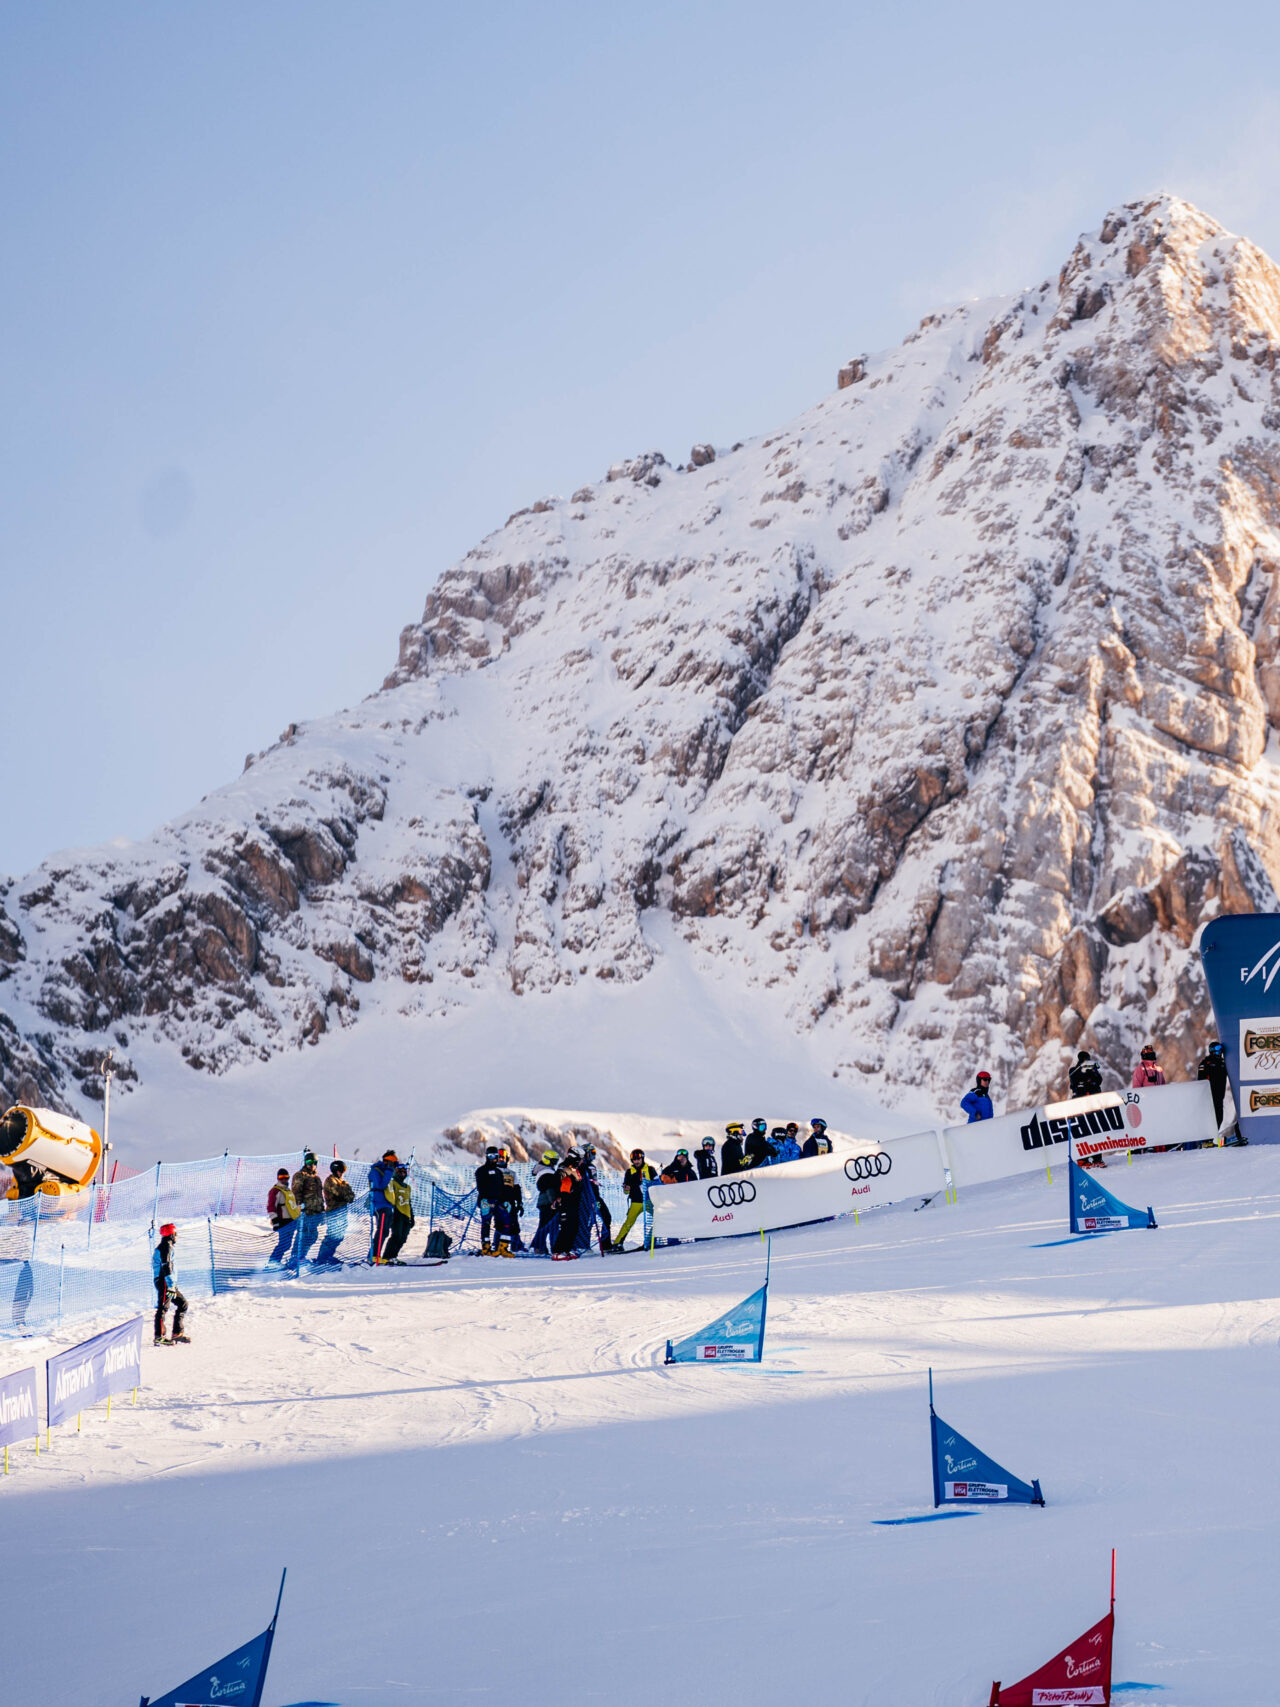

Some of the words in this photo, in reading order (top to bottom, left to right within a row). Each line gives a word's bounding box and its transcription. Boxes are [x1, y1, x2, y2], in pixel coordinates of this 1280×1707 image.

[1076, 1134, 1147, 1156] illuminazione
[851, 1185, 871, 1196] Audi
[711, 1213, 734, 1223] Audi
[1064, 1655, 1101, 1679] Cortina
